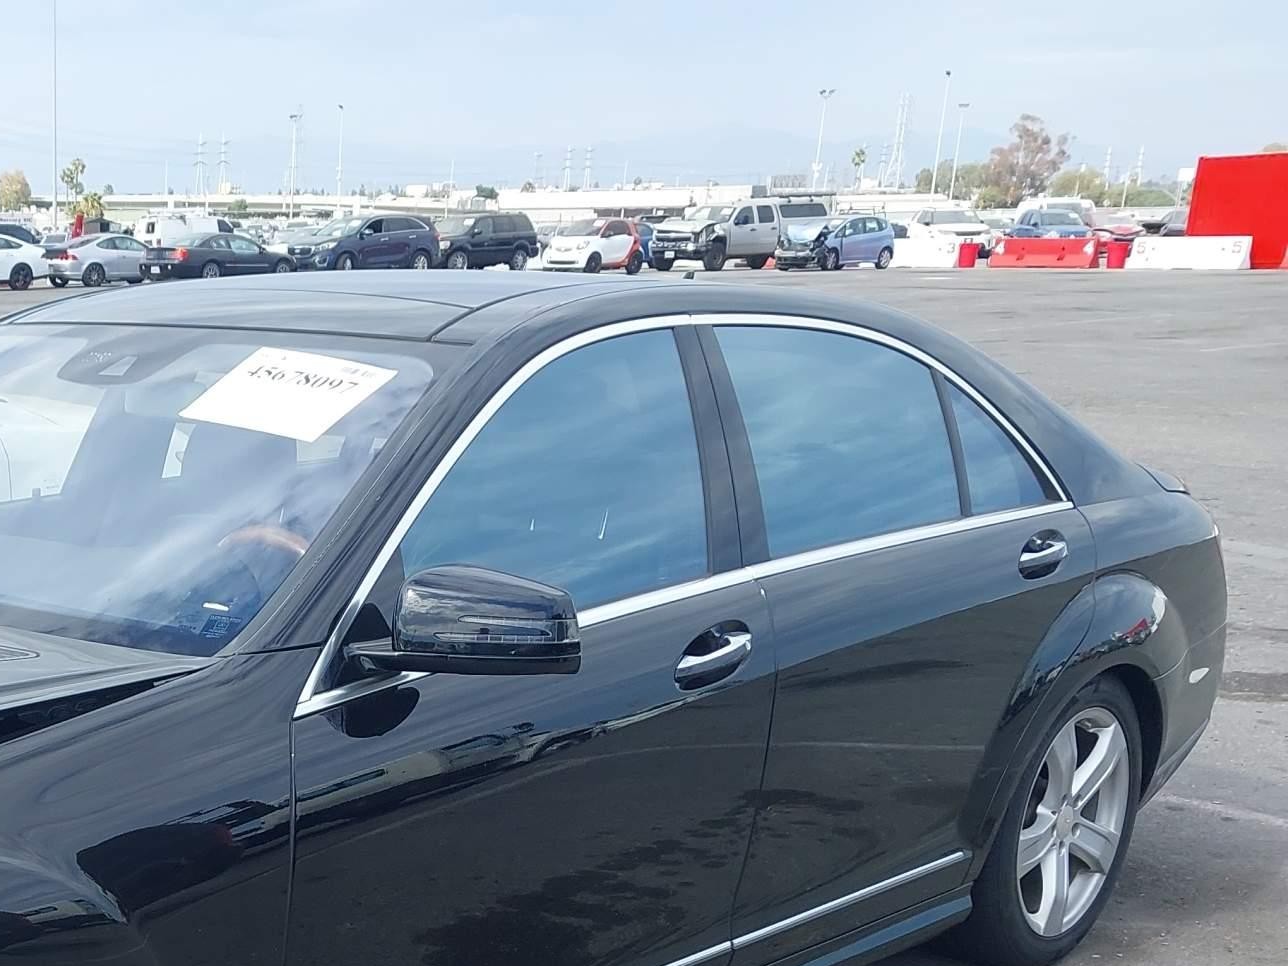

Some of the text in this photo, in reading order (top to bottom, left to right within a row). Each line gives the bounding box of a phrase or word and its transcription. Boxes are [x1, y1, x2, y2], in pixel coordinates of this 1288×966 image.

[947, 243, 956, 254] 3
[1137, 241, 1146, 254] 5
[1231, 240, 1243, 254] 5
[248, 365, 359, 394] 45678097
